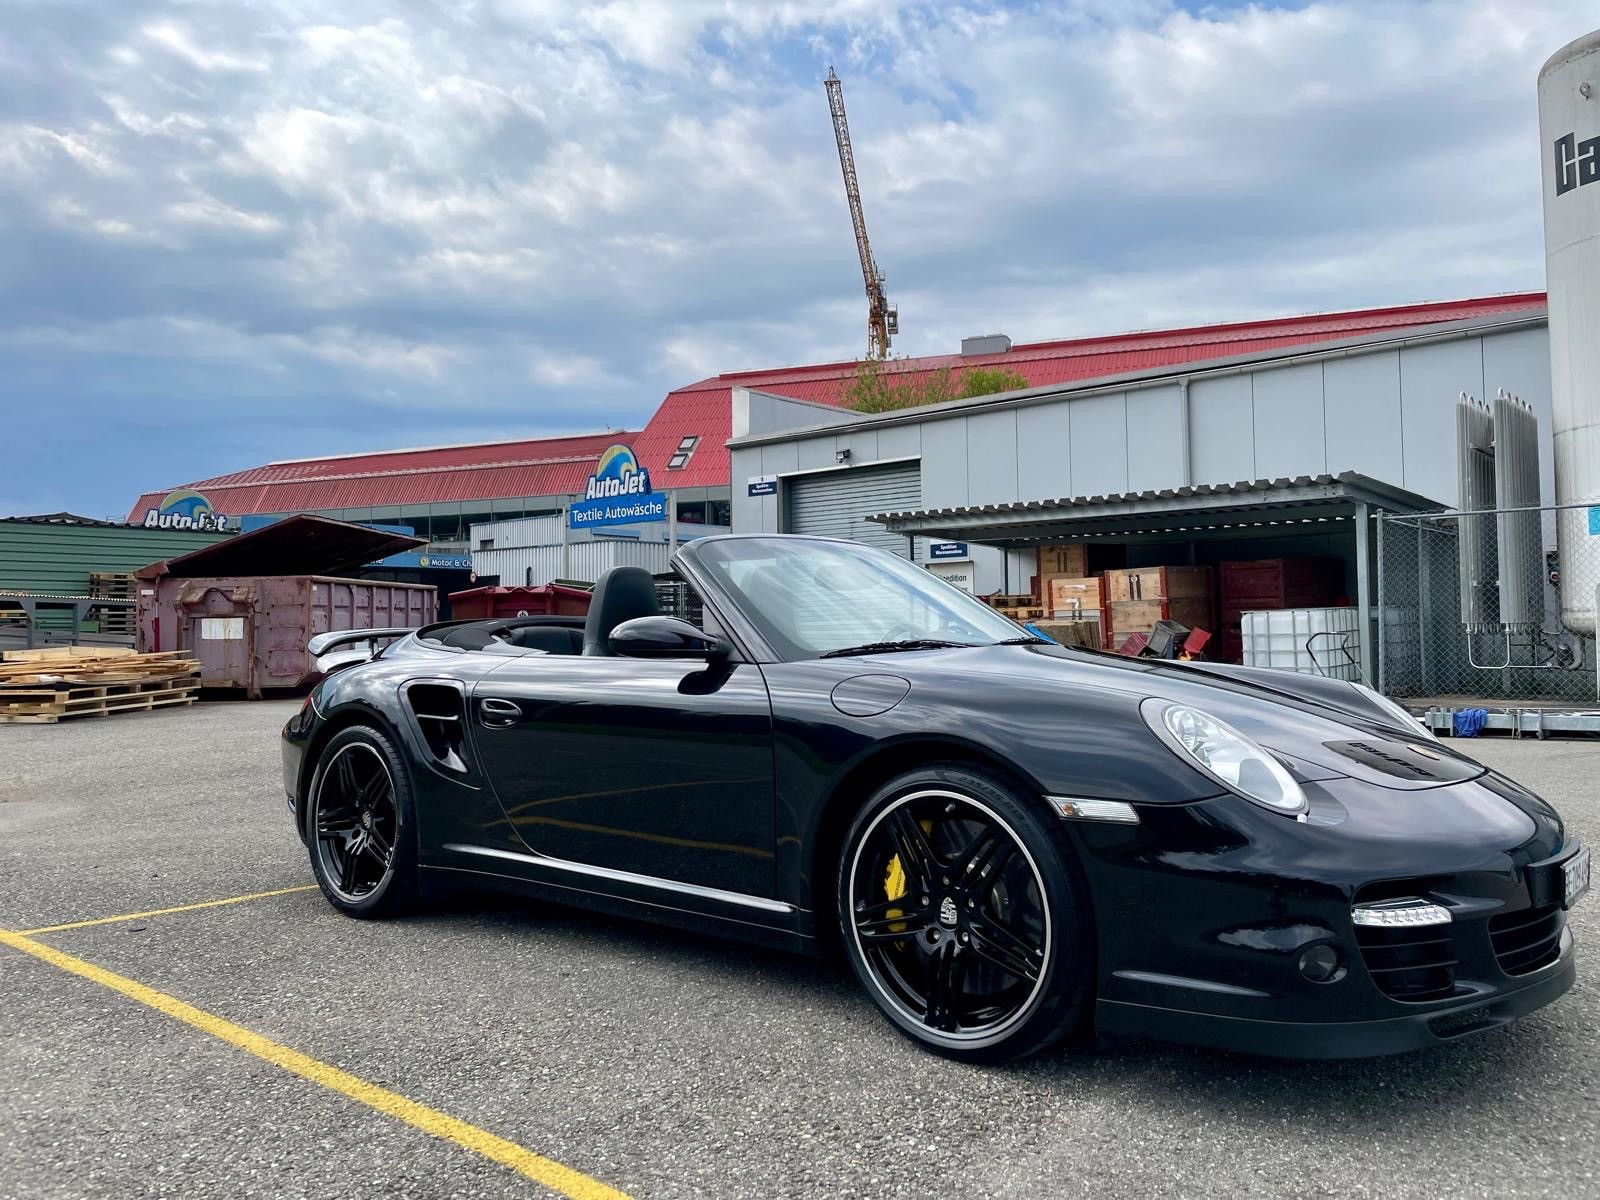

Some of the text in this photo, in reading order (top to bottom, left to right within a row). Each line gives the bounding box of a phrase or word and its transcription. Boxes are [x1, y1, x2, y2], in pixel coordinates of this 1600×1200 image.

[586, 471, 646, 500] AutoJet
[573, 502, 662, 523] Textile Autowäsche
